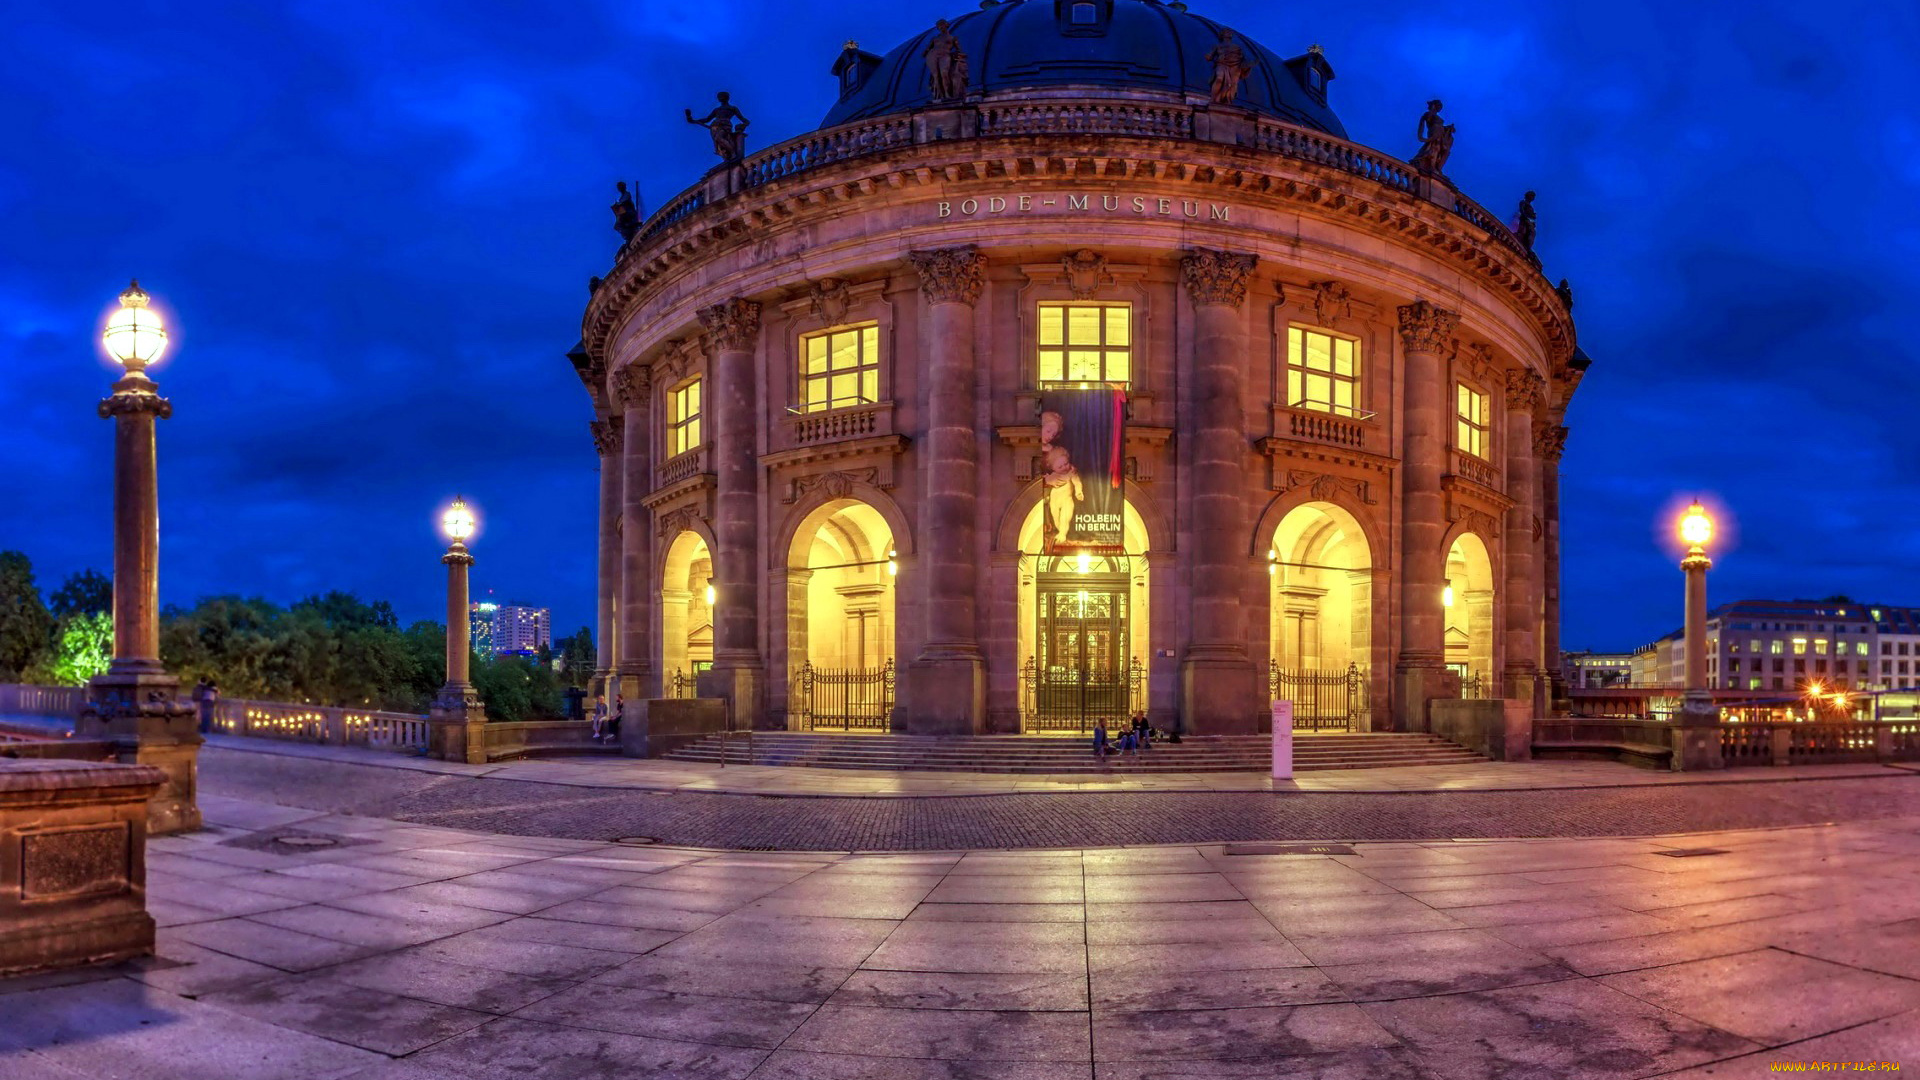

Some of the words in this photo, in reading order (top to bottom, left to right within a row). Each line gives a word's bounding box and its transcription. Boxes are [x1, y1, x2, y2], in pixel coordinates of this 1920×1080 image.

[938, 194, 1230, 221] BODE-MUSEUM
[1075, 514, 1121, 523] HOLBEIN
[1075, 523, 1086, 531] IN
[1087, 523, 1121, 531] BERLIN
